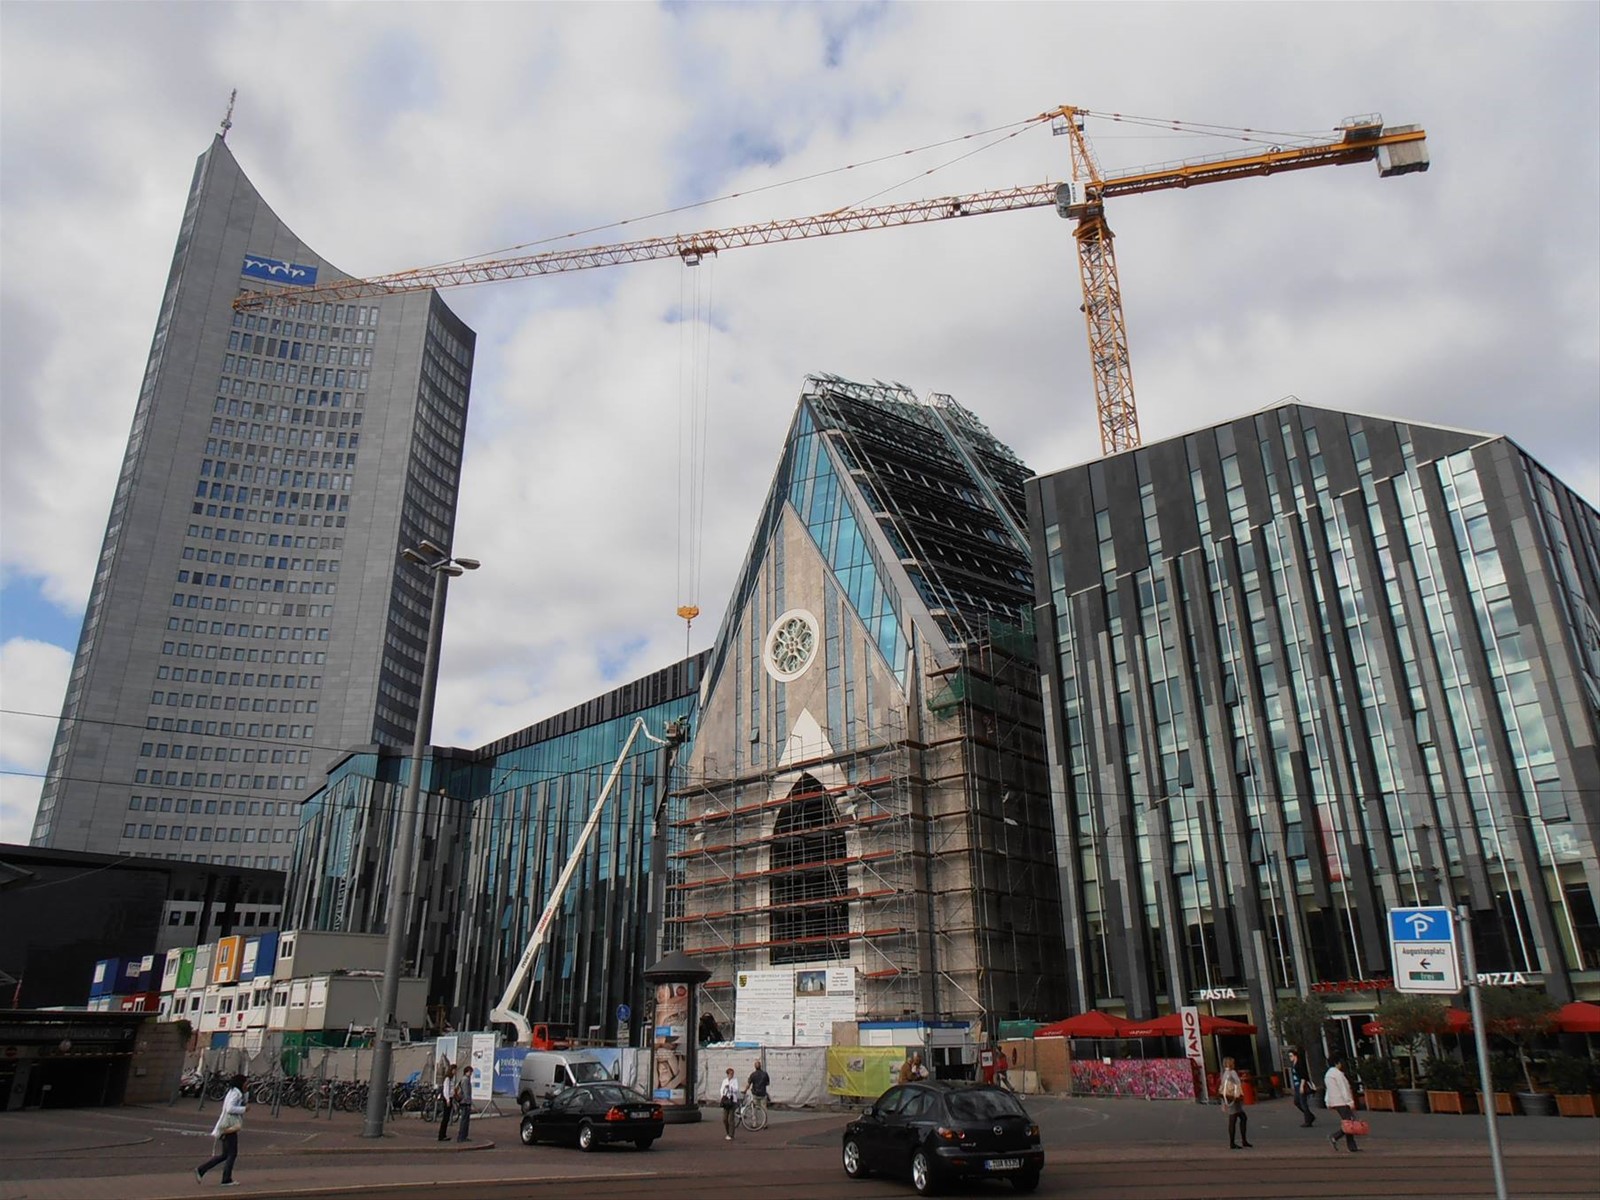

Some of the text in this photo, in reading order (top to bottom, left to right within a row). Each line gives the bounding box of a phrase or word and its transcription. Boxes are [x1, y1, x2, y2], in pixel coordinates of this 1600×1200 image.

[244, 258, 305, 279] mdr
[1402, 946, 1446, 957] Augustusplatz
[1476, 971, 1527, 986] PIZZA
[1200, 988, 1236, 1000] PASTA
